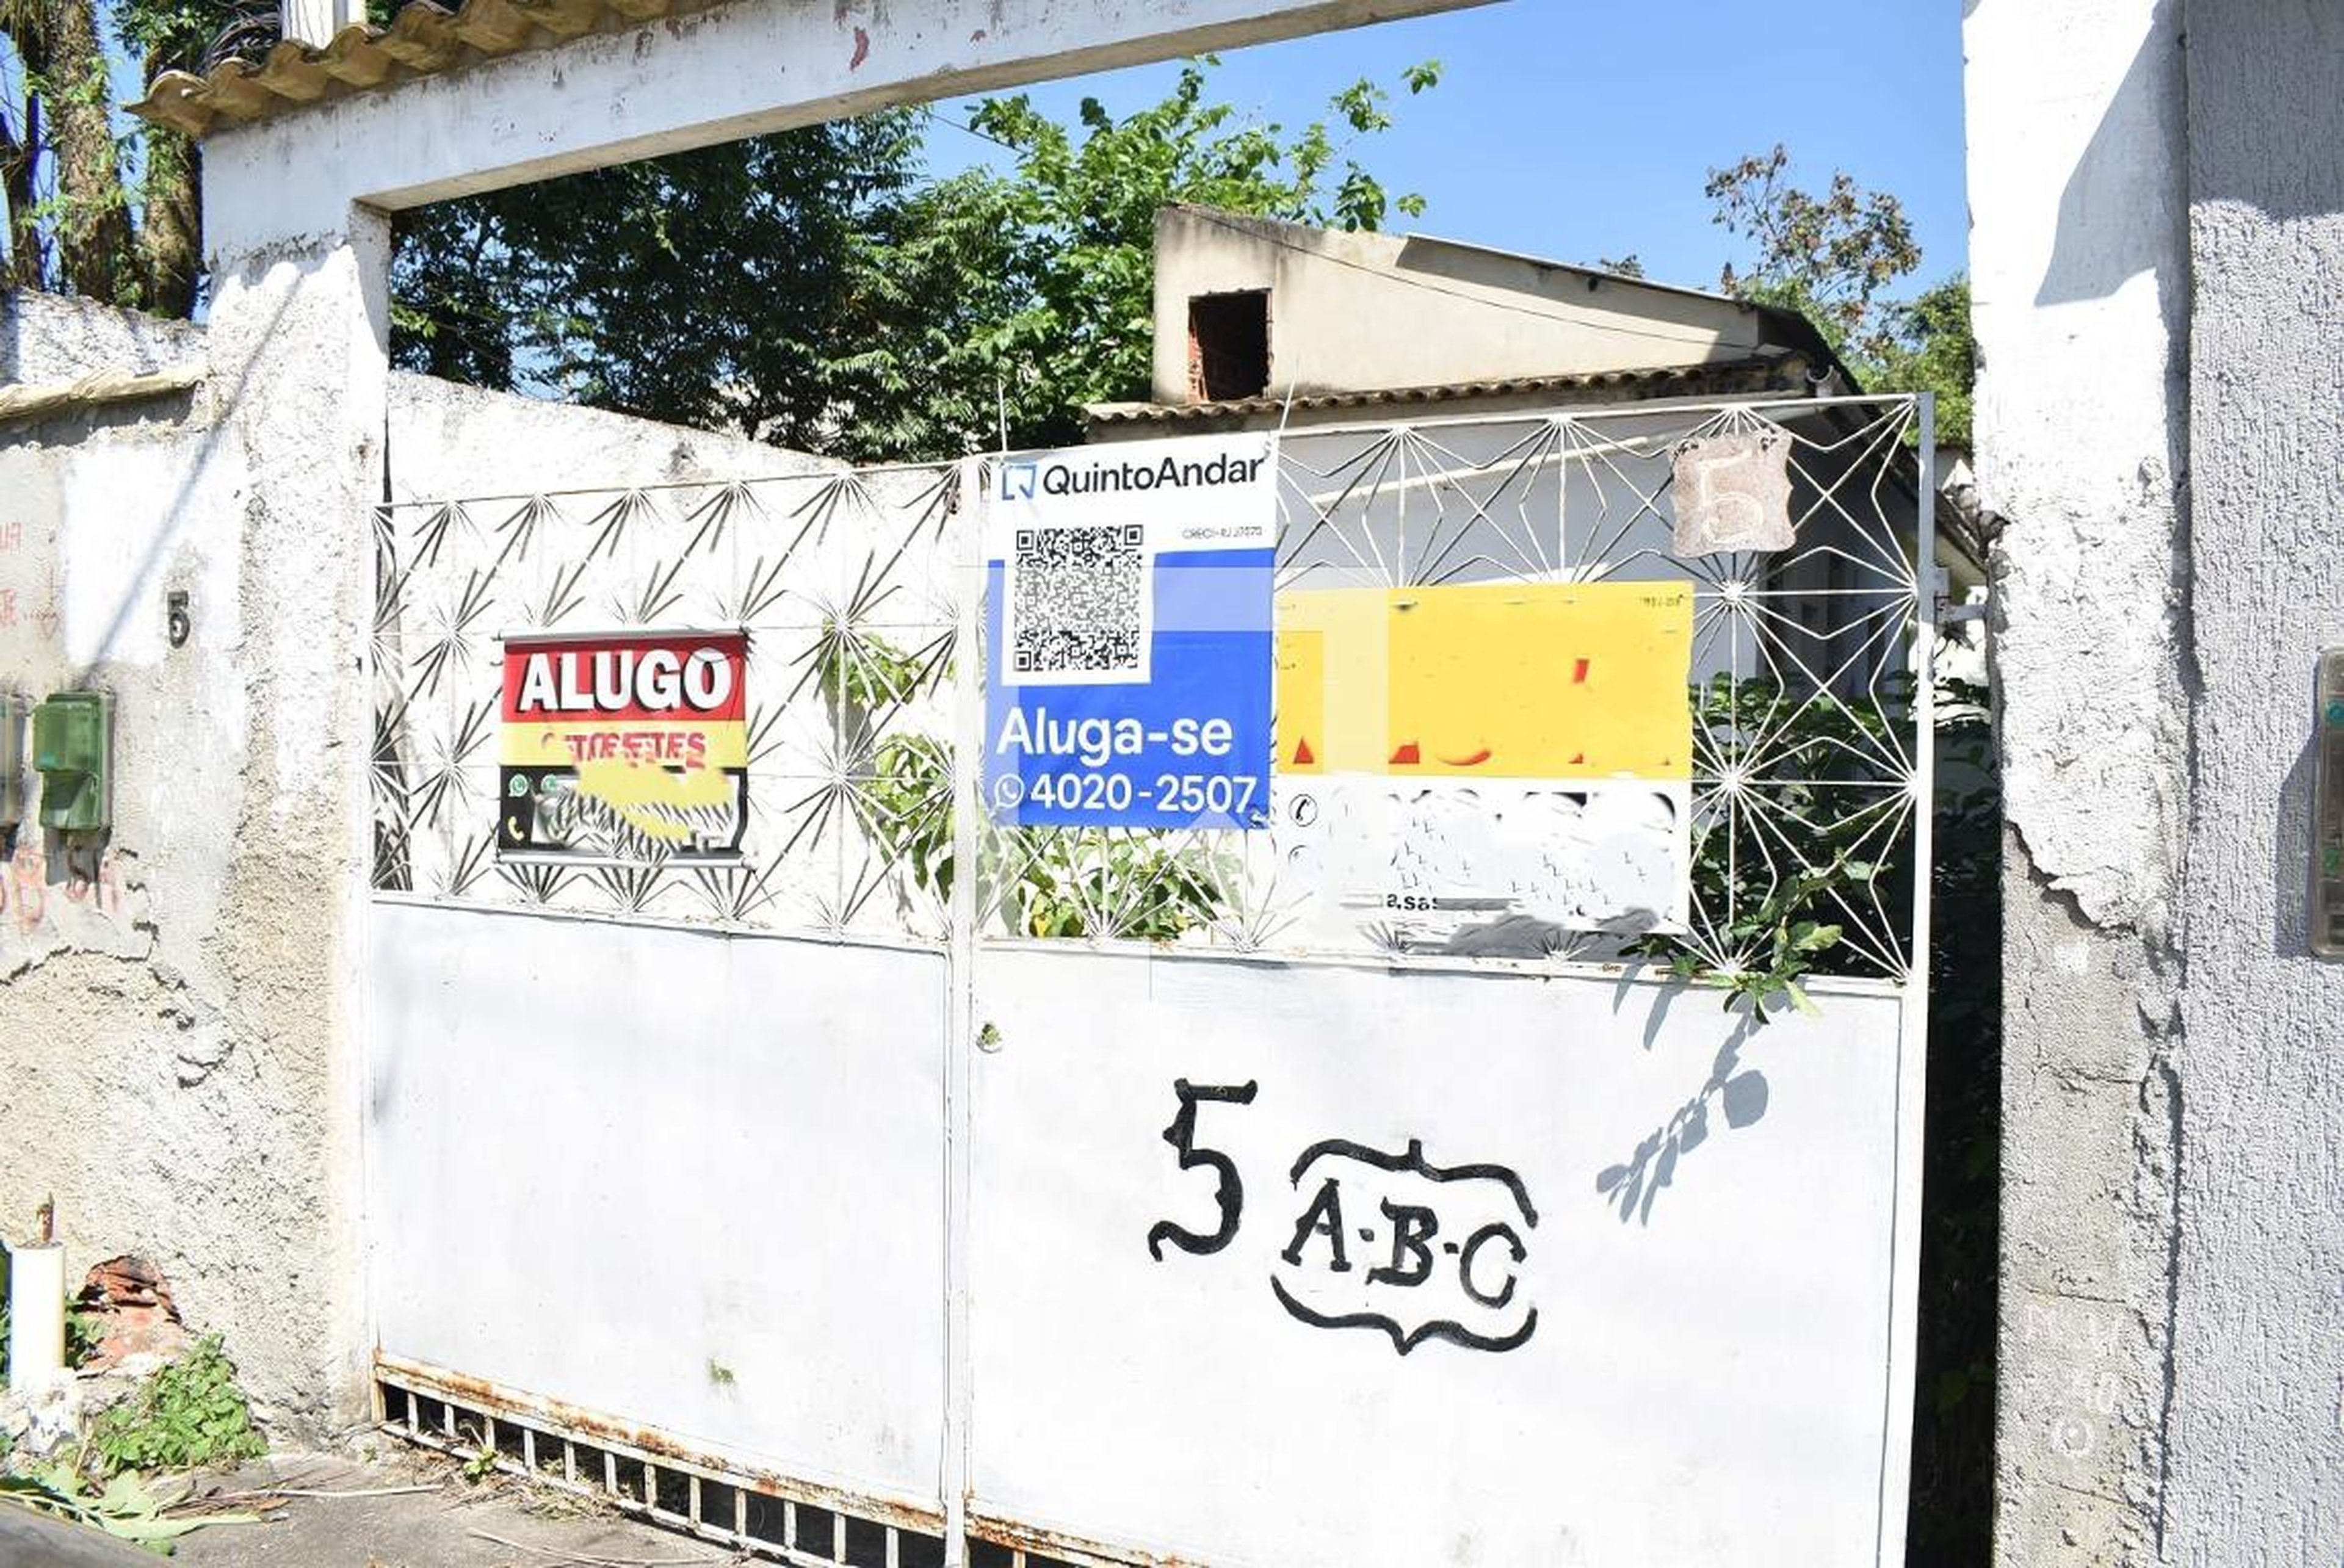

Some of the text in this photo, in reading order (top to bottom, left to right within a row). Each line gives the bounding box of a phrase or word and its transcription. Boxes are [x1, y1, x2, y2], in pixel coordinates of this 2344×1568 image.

[1043, 453, 1264, 496] QuintoAndar
[167, 591, 190, 649] 5
[516, 647, 732, 712] ALUGO
[996, 707, 1232, 768] Aluga-se
[1030, 772, 1258, 814] 4020-2507
[1148, 1077, 1258, 1262] 5
